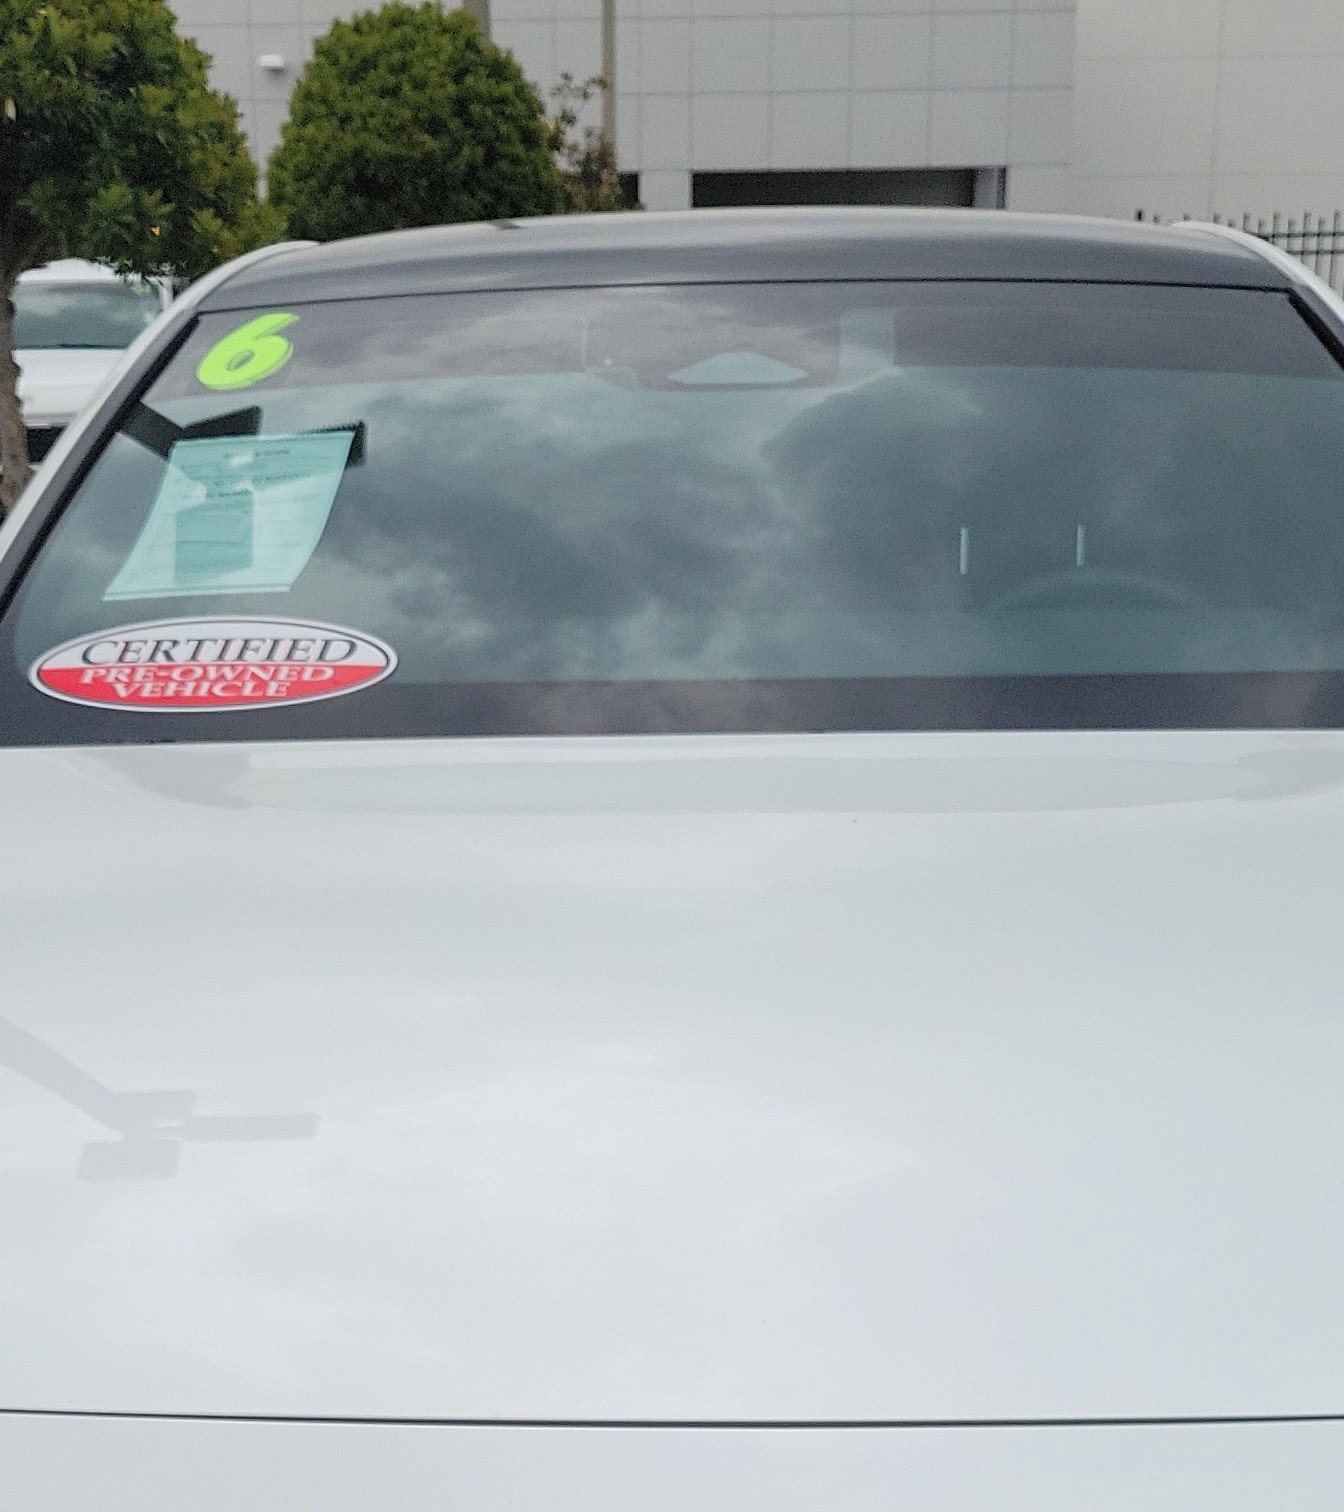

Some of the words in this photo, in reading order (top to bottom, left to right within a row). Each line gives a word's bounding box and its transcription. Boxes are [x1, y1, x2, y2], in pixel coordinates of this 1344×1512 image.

[197, 312, 300, 391] 6
[81, 638, 357, 665] CERTIFIED
[79, 665, 335, 684] PRE-OWNED
[113, 681, 293, 698] VEHICLE
